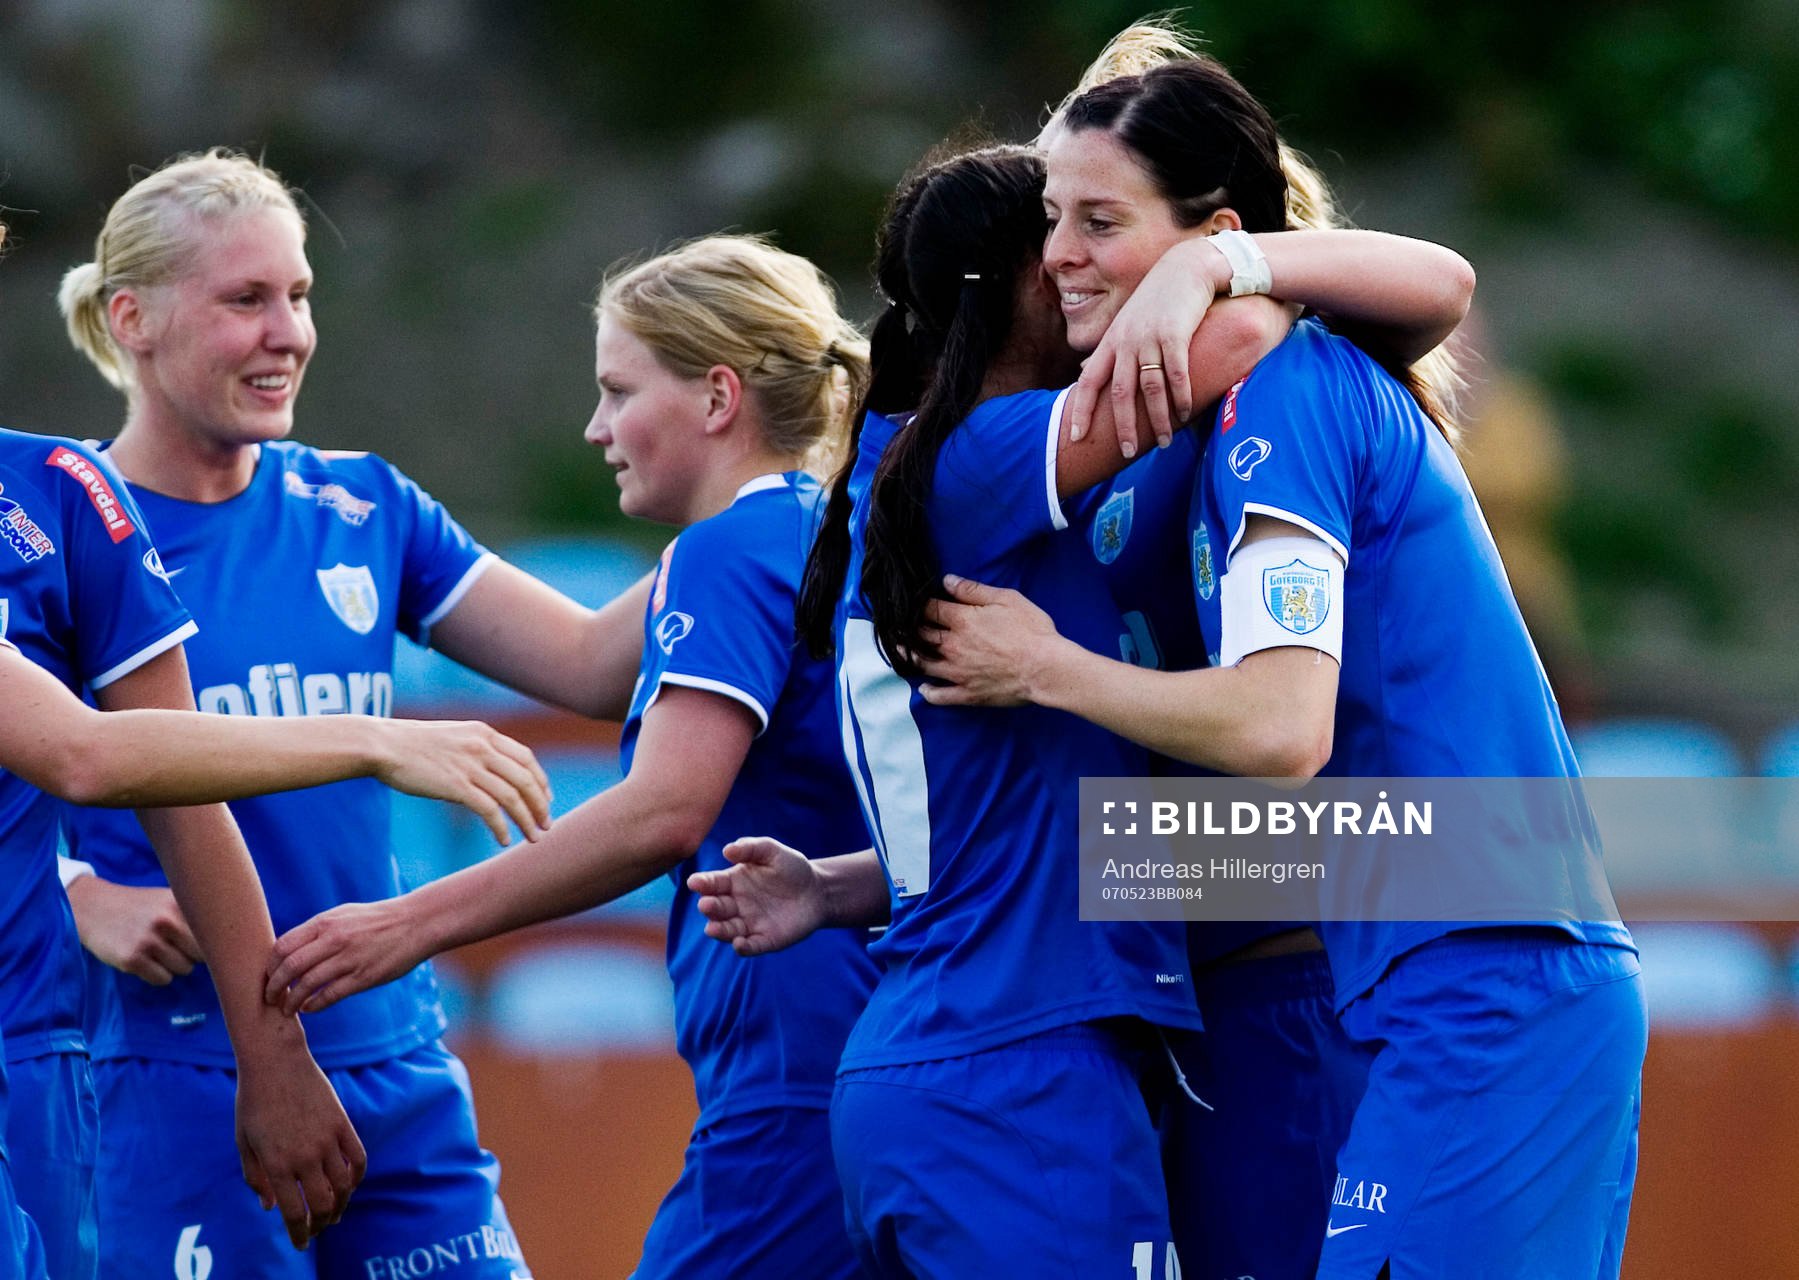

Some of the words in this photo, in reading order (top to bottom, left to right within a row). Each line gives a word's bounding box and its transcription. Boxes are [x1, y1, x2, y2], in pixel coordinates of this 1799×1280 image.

[57, 453, 126, 530] stavdal
[0, 519, 40, 561] SPORT
[9, 510, 52, 555] INTER
[1332, 1172, 1388, 1214] ILAR
[174, 1224, 212, 1280] 6
